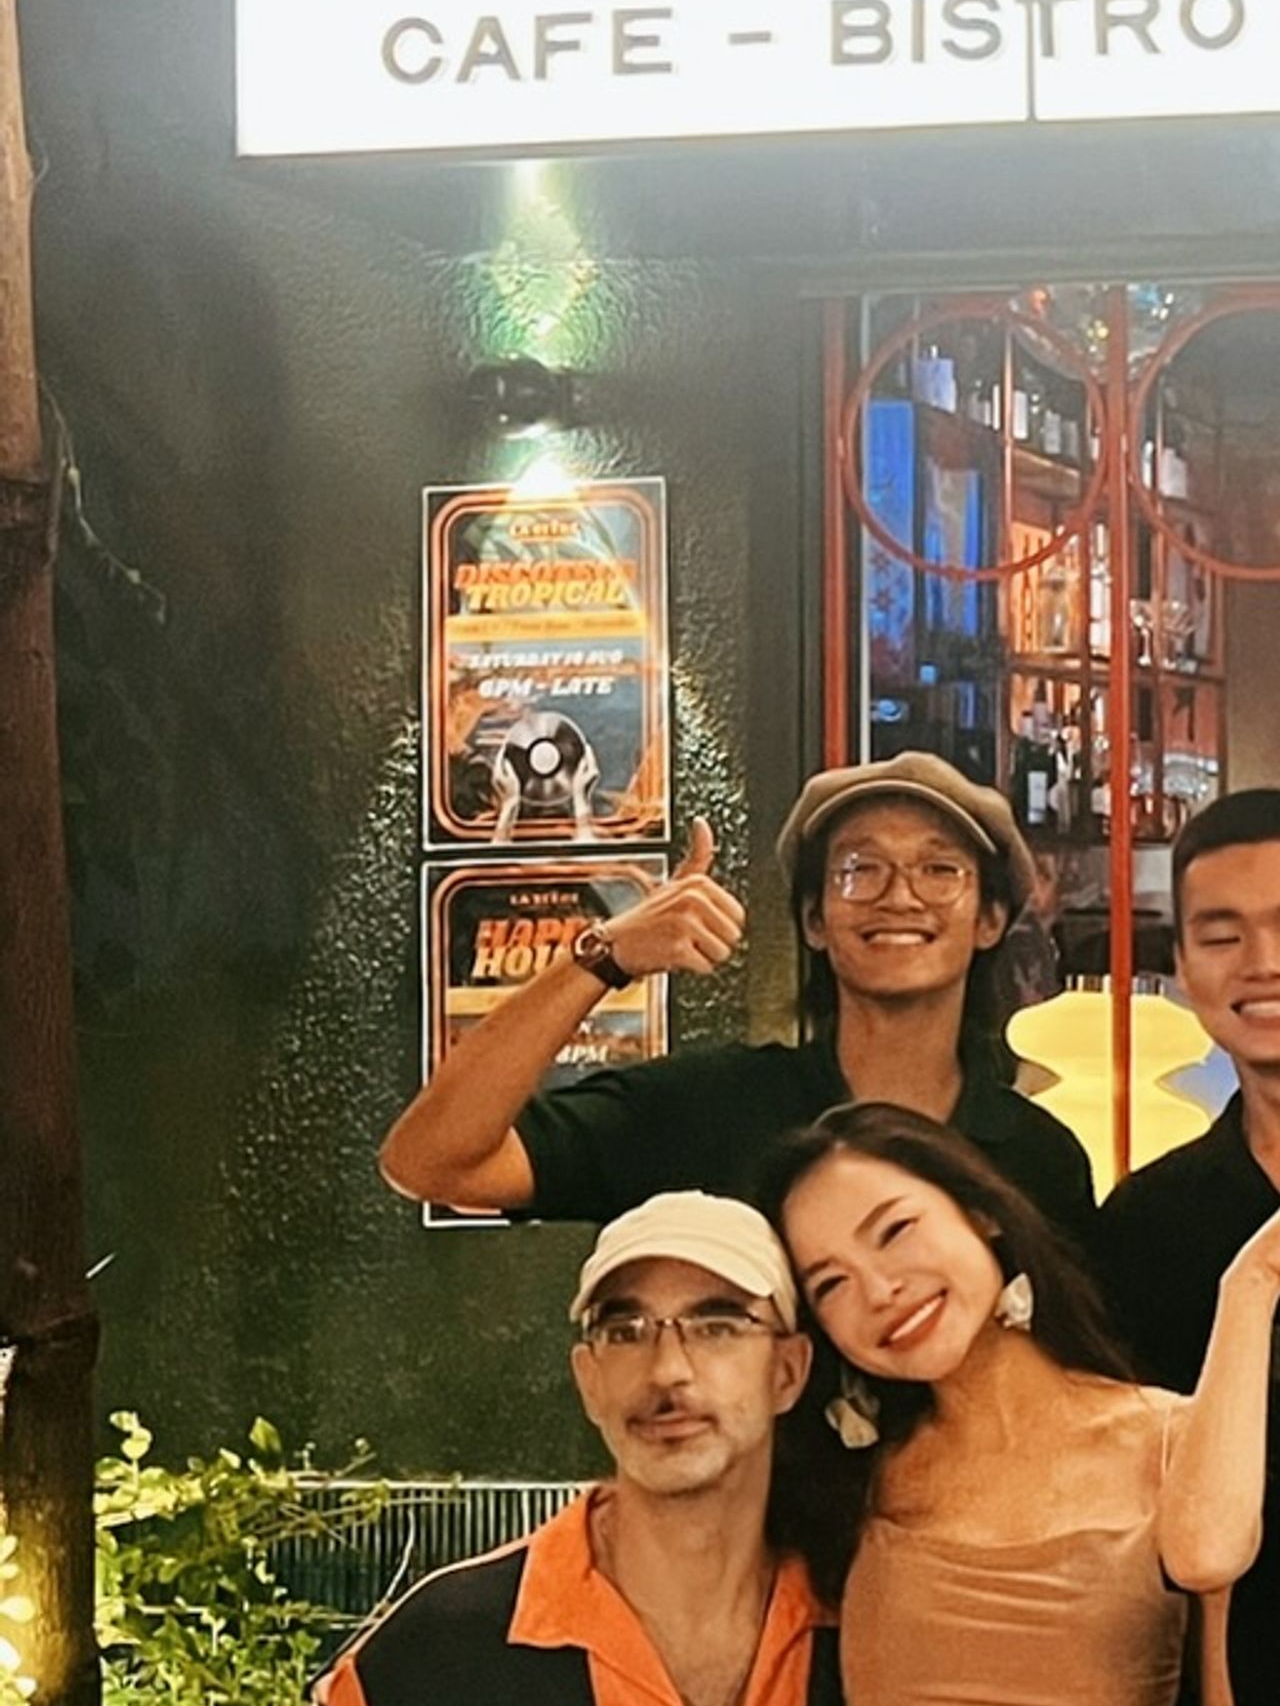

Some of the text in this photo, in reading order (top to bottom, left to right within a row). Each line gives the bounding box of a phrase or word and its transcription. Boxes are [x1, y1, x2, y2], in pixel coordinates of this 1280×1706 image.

[379, 6, 674, 85] CAFE
[465, 579, 627, 610] TROPICAL
[549, 675, 616, 696] LATE
[475, 917, 586, 949] HAPP
[471, 946, 568, 978] HOU
